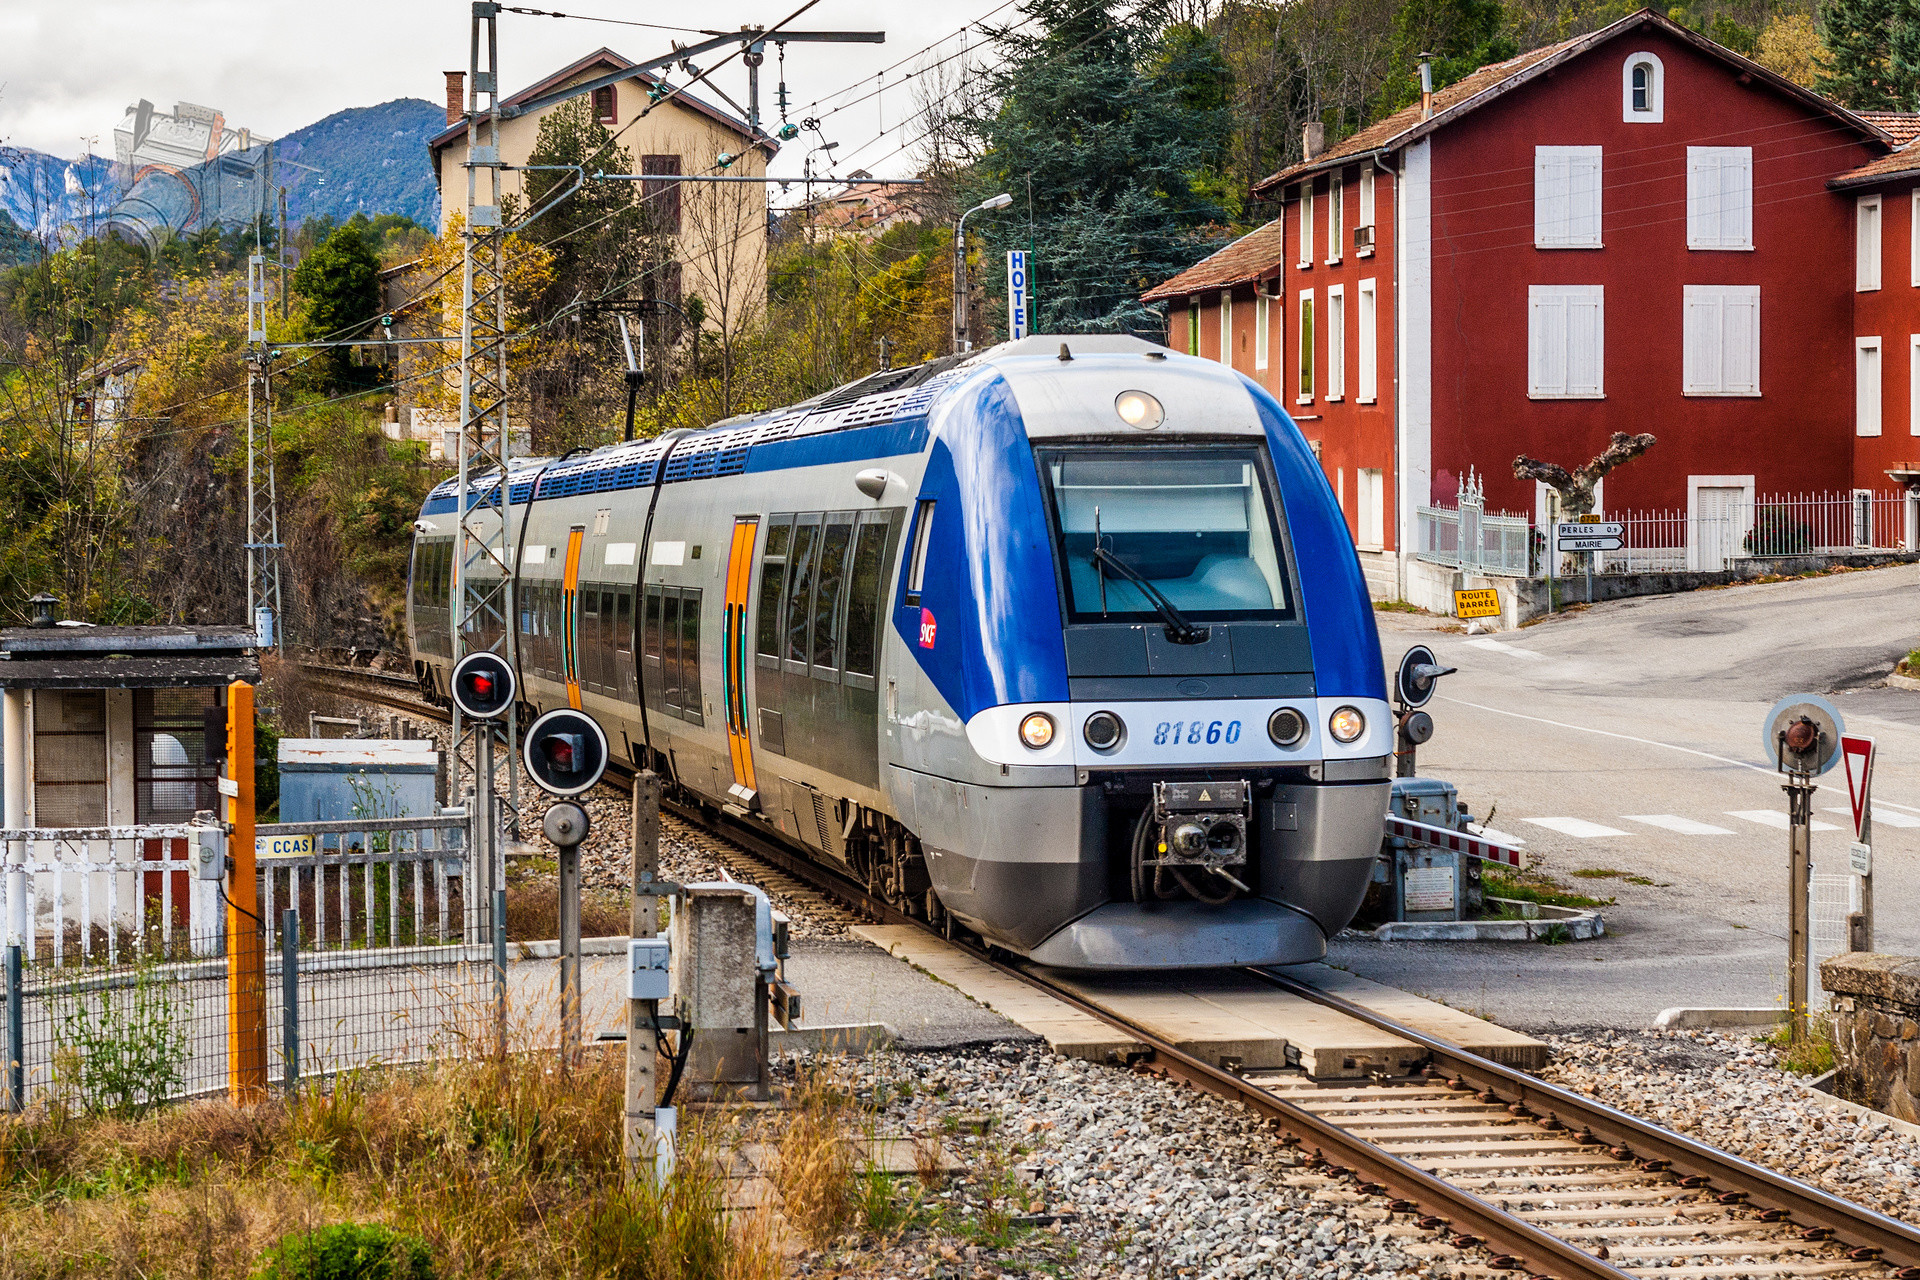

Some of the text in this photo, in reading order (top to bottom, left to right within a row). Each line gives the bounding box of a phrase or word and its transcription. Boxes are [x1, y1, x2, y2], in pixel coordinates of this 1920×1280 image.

[1561, 526, 1594, 534] PERLES
[1575, 540, 1602, 548] MAIRIE
[1461, 591, 1491, 600] ROUTE
[1460, 599, 1496, 609] BARRÉE
[919, 622, 936, 644] SNCF
[1153, 720, 1242, 746] 81860
[273, 839, 309, 854] CCAS
